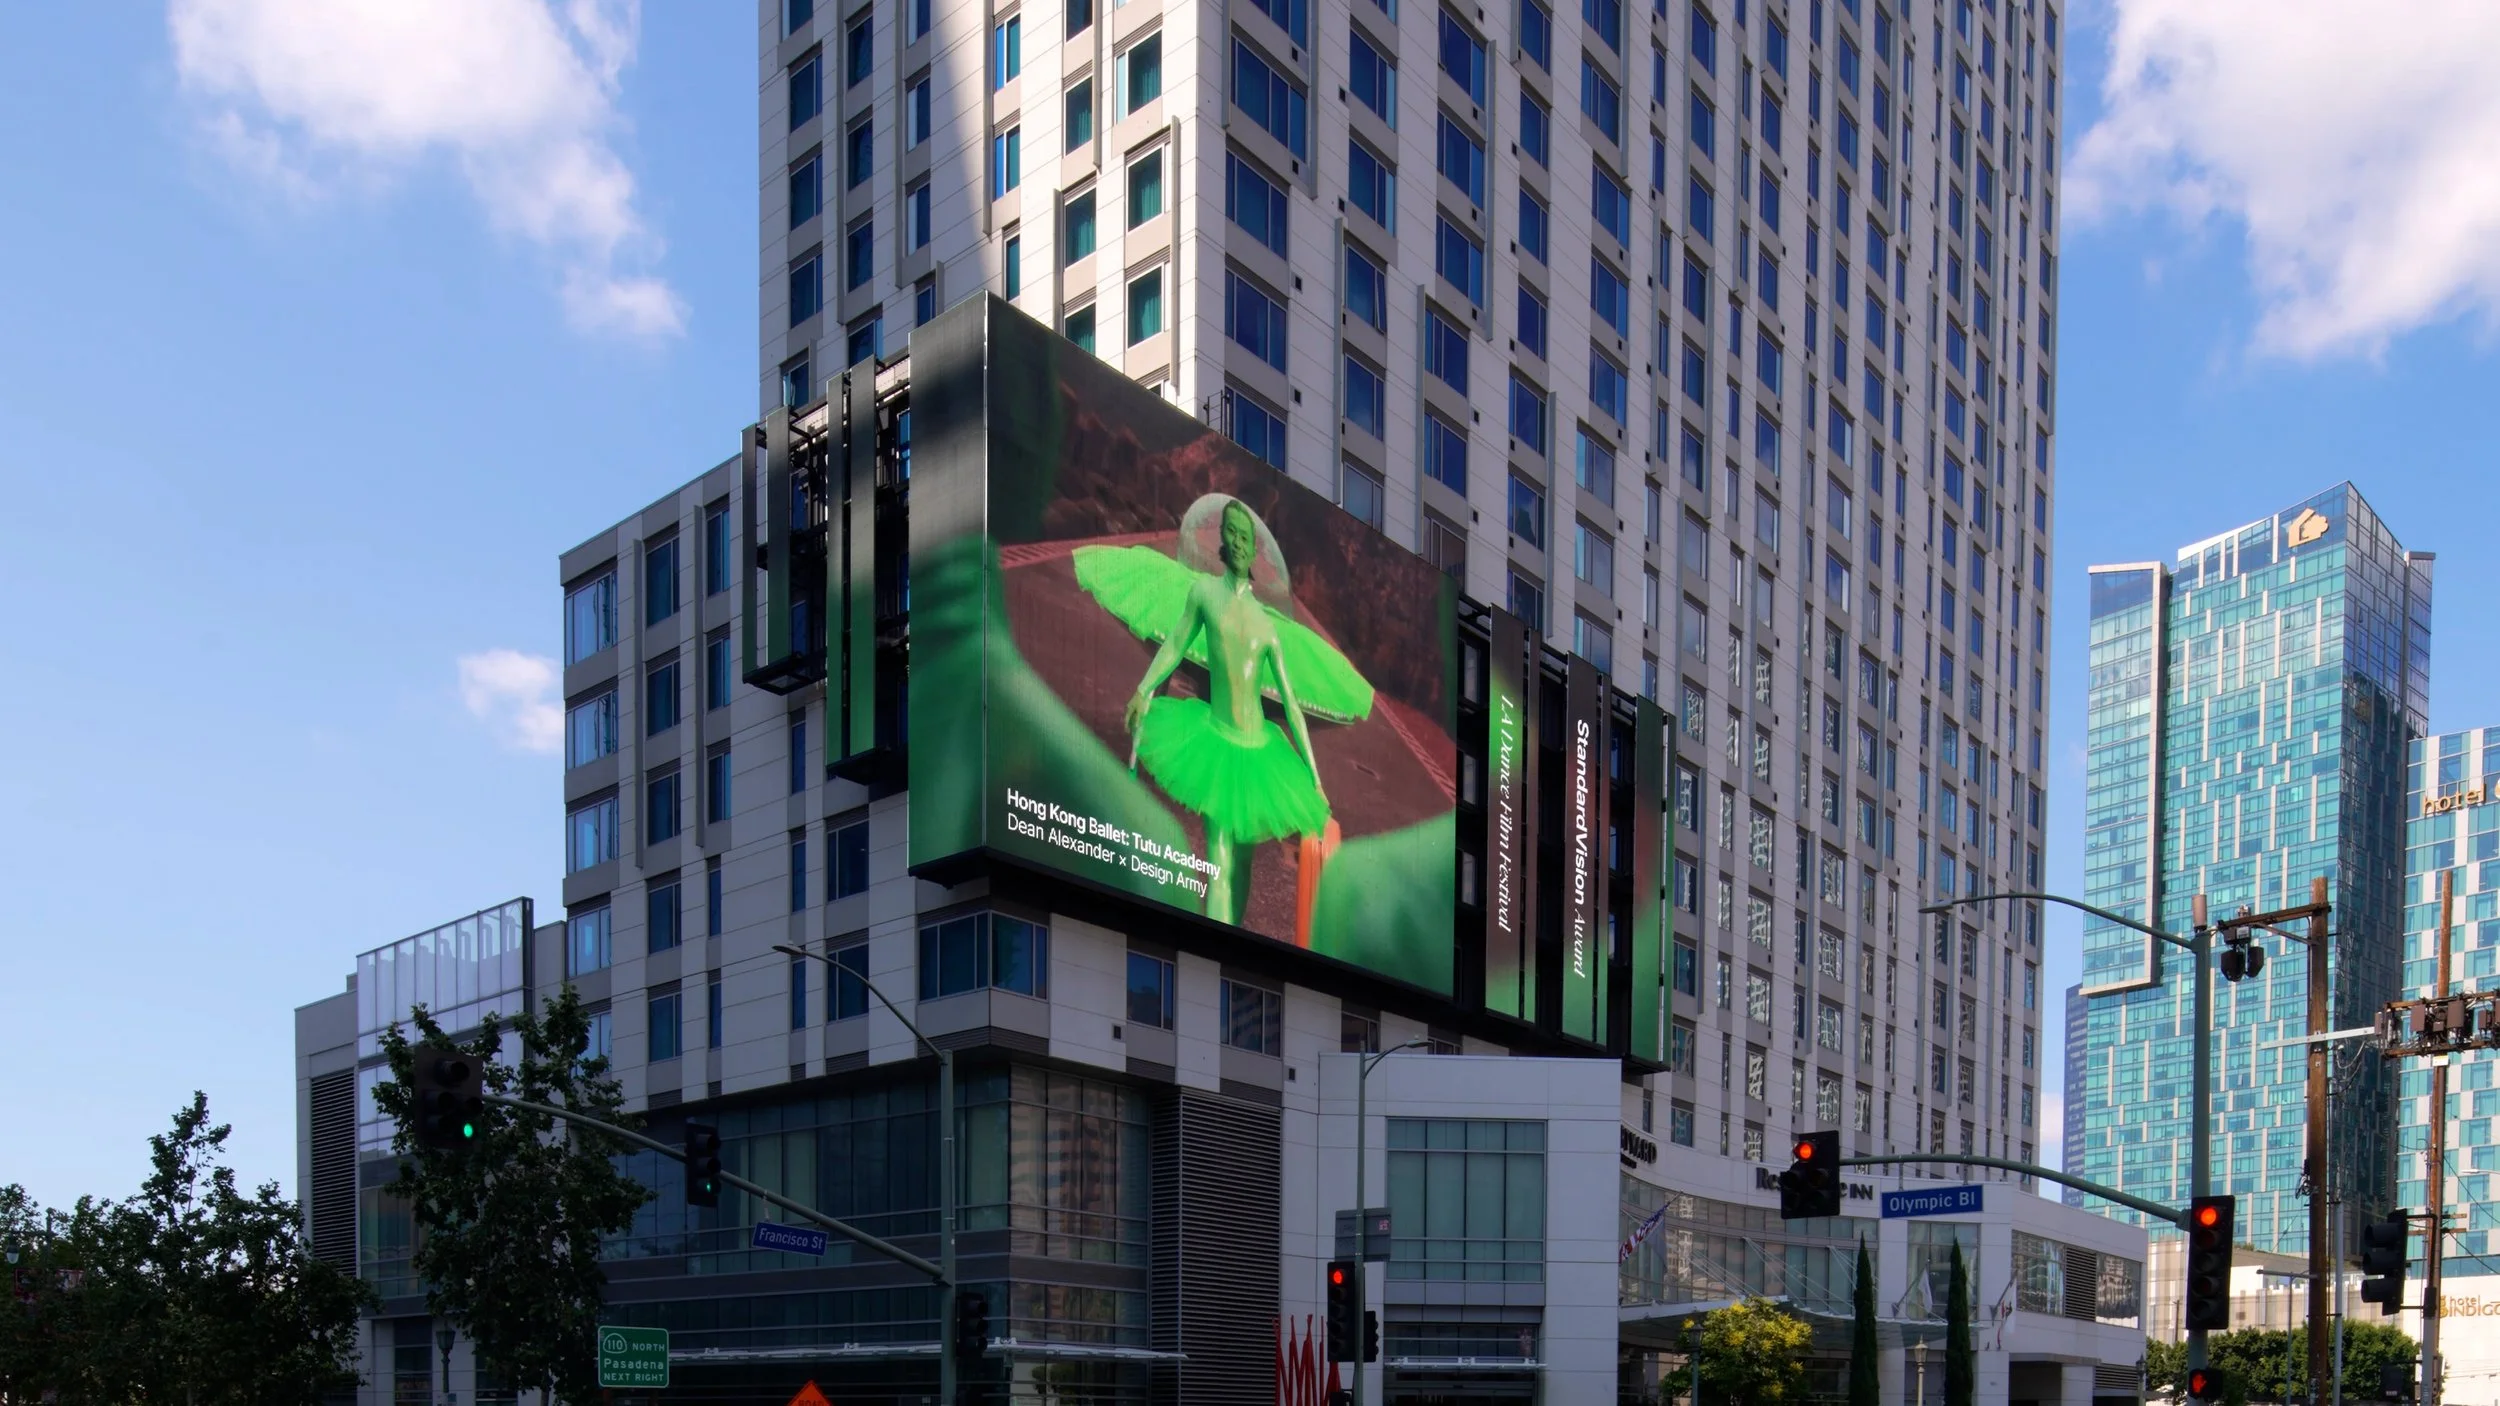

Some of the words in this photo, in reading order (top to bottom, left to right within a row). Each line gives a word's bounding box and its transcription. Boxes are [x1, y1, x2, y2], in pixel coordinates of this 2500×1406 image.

[1501, 695, 1514, 725] LA
[1501, 729, 1513, 799] Dance
[1575, 719, 1590, 905] StandardVision
[2422, 783, 2487, 817] hotel
[1007, 788, 1047, 821] Hong
[1049, 802, 1086, 834] Kong
[1089, 816, 1130, 846] Ballet:
[1132, 832, 1161, 857] Tutu
[1163, 845, 1221, 880] Academy
[1500, 800, 1513, 849] Film
[1007, 813, 1044, 841] Dean
[1048, 827, 1116, 864] Alexander
[1131, 854, 1174, 885] Design
[1176, 871, 1208, 898] Army
[1499, 851, 1512, 932] Festival
[1574, 908, 1586, 978] Award
[1849, 1183, 1873, 1200] INN
[1889, 1194, 1953, 1214] Olympic
[1959, 1191, 1975, 1206] Bl
[759, 1227, 808, 1247] Francisco
[811, 1235, 823, 1249] St
[2450, 1294, 2481, 1306] hotel
[607, 1339, 623, 1350] 110
[632, 1343, 665, 1352] NORTH
[603, 1358, 664, 1370] Pasadena
[603, 1372, 630, 1381] NEXT
[635, 1373, 664, 1382] RIGHT
